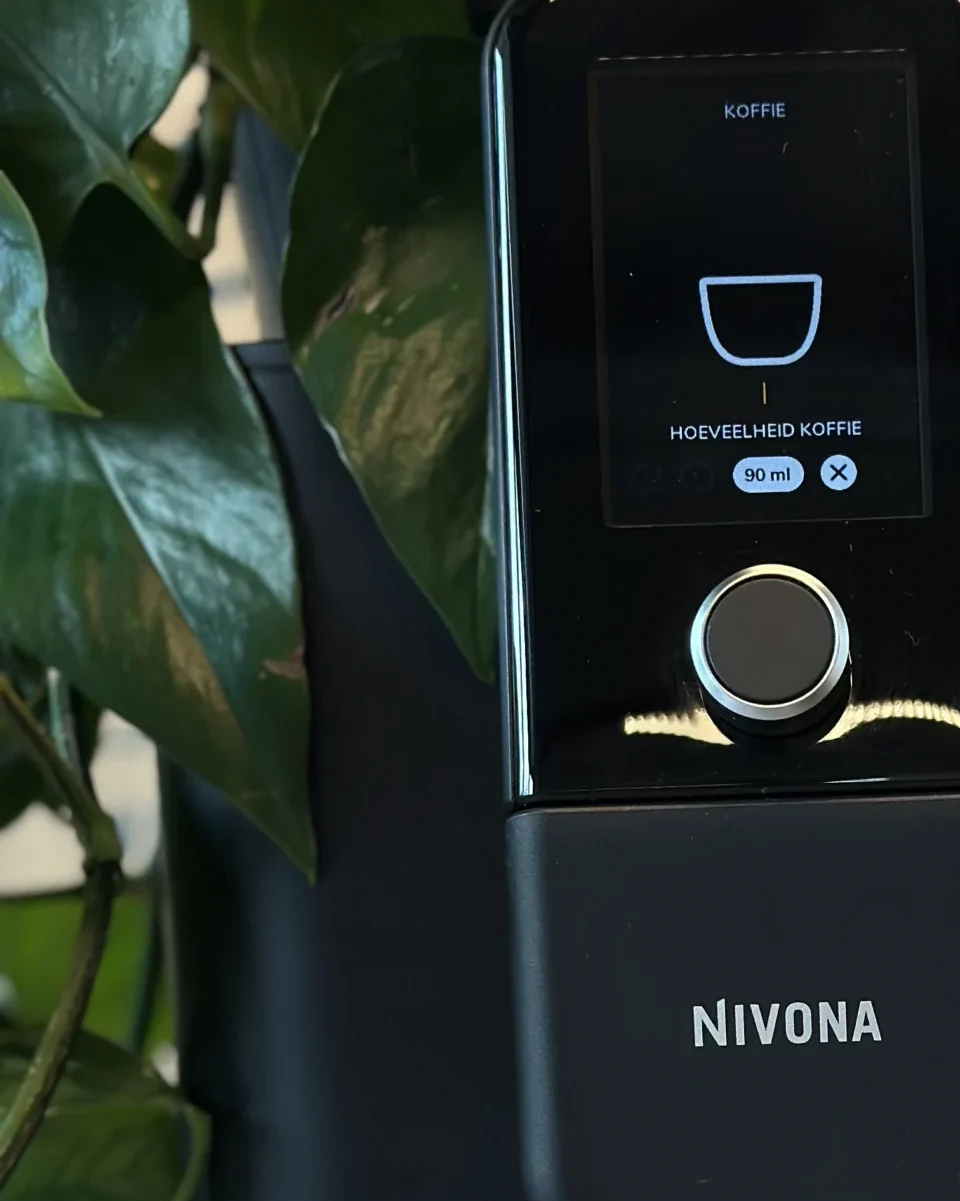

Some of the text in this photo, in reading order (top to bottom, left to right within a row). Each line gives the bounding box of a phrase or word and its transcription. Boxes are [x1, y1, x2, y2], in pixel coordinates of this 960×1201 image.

[724, 102, 786, 119] KOFFIE
[670, 420, 862, 441] HOEVEELHEID KOFFIE
[744, 466, 791, 482] 90 ml
[692, 998, 882, 1047] NIVONA
